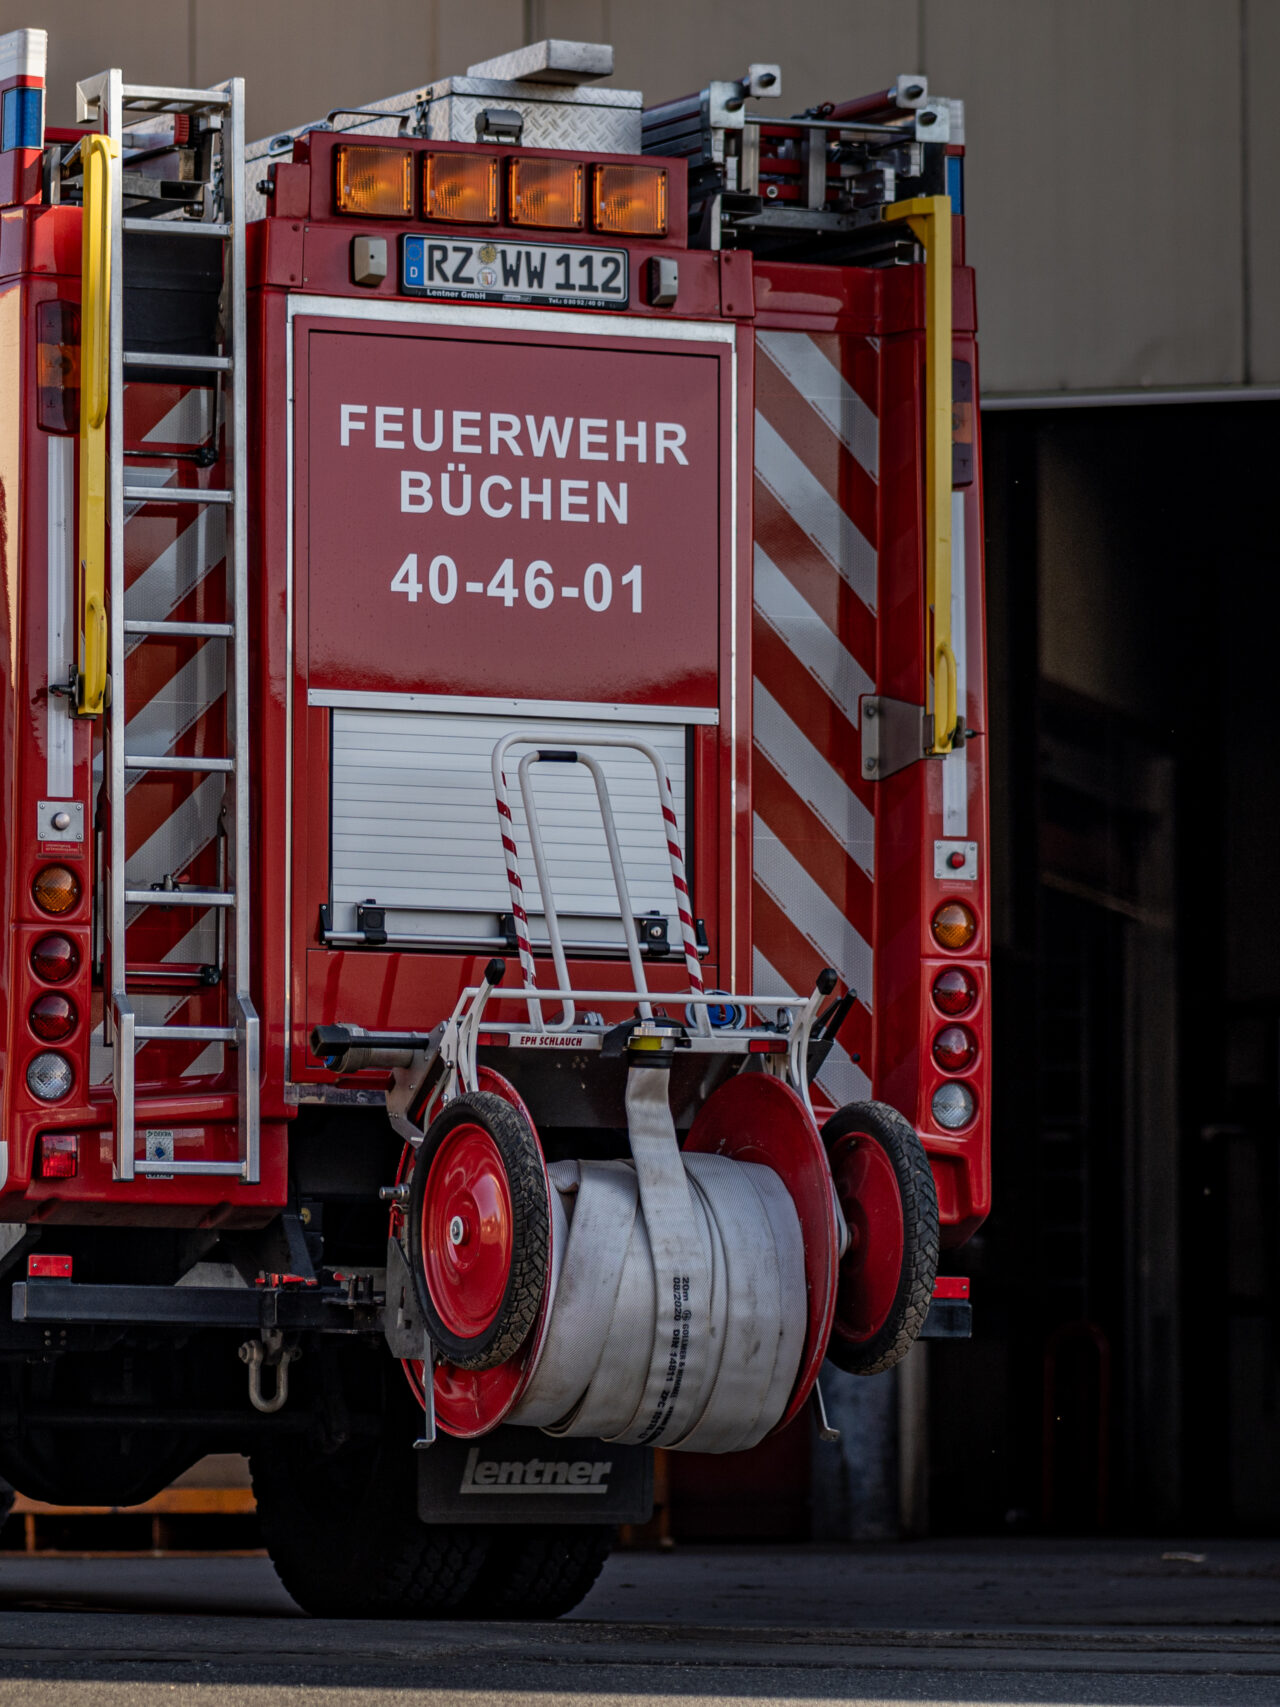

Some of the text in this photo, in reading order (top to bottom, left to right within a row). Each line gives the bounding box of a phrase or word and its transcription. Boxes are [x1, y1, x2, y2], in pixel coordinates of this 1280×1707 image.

[410, 266, 418, 279] D
[428, 244, 622, 294] RZ WW 112
[426, 289, 486, 300] Lentner GmbH
[339, 403, 690, 466] FEUERWEHR
[400, 463, 629, 525] BÜCHEN
[390, 553, 644, 614] 40-46-01
[520, 1036, 583, 1046] EPH SCHLAUCH
[672, 1277, 682, 1321] 08/2020
[681, 1276, 690, 1301] 20m
[669, 1329, 680, 1352] DIN
[665, 1352, 680, 1382] 14811
[459, 1447, 613, 1494] Lentner
